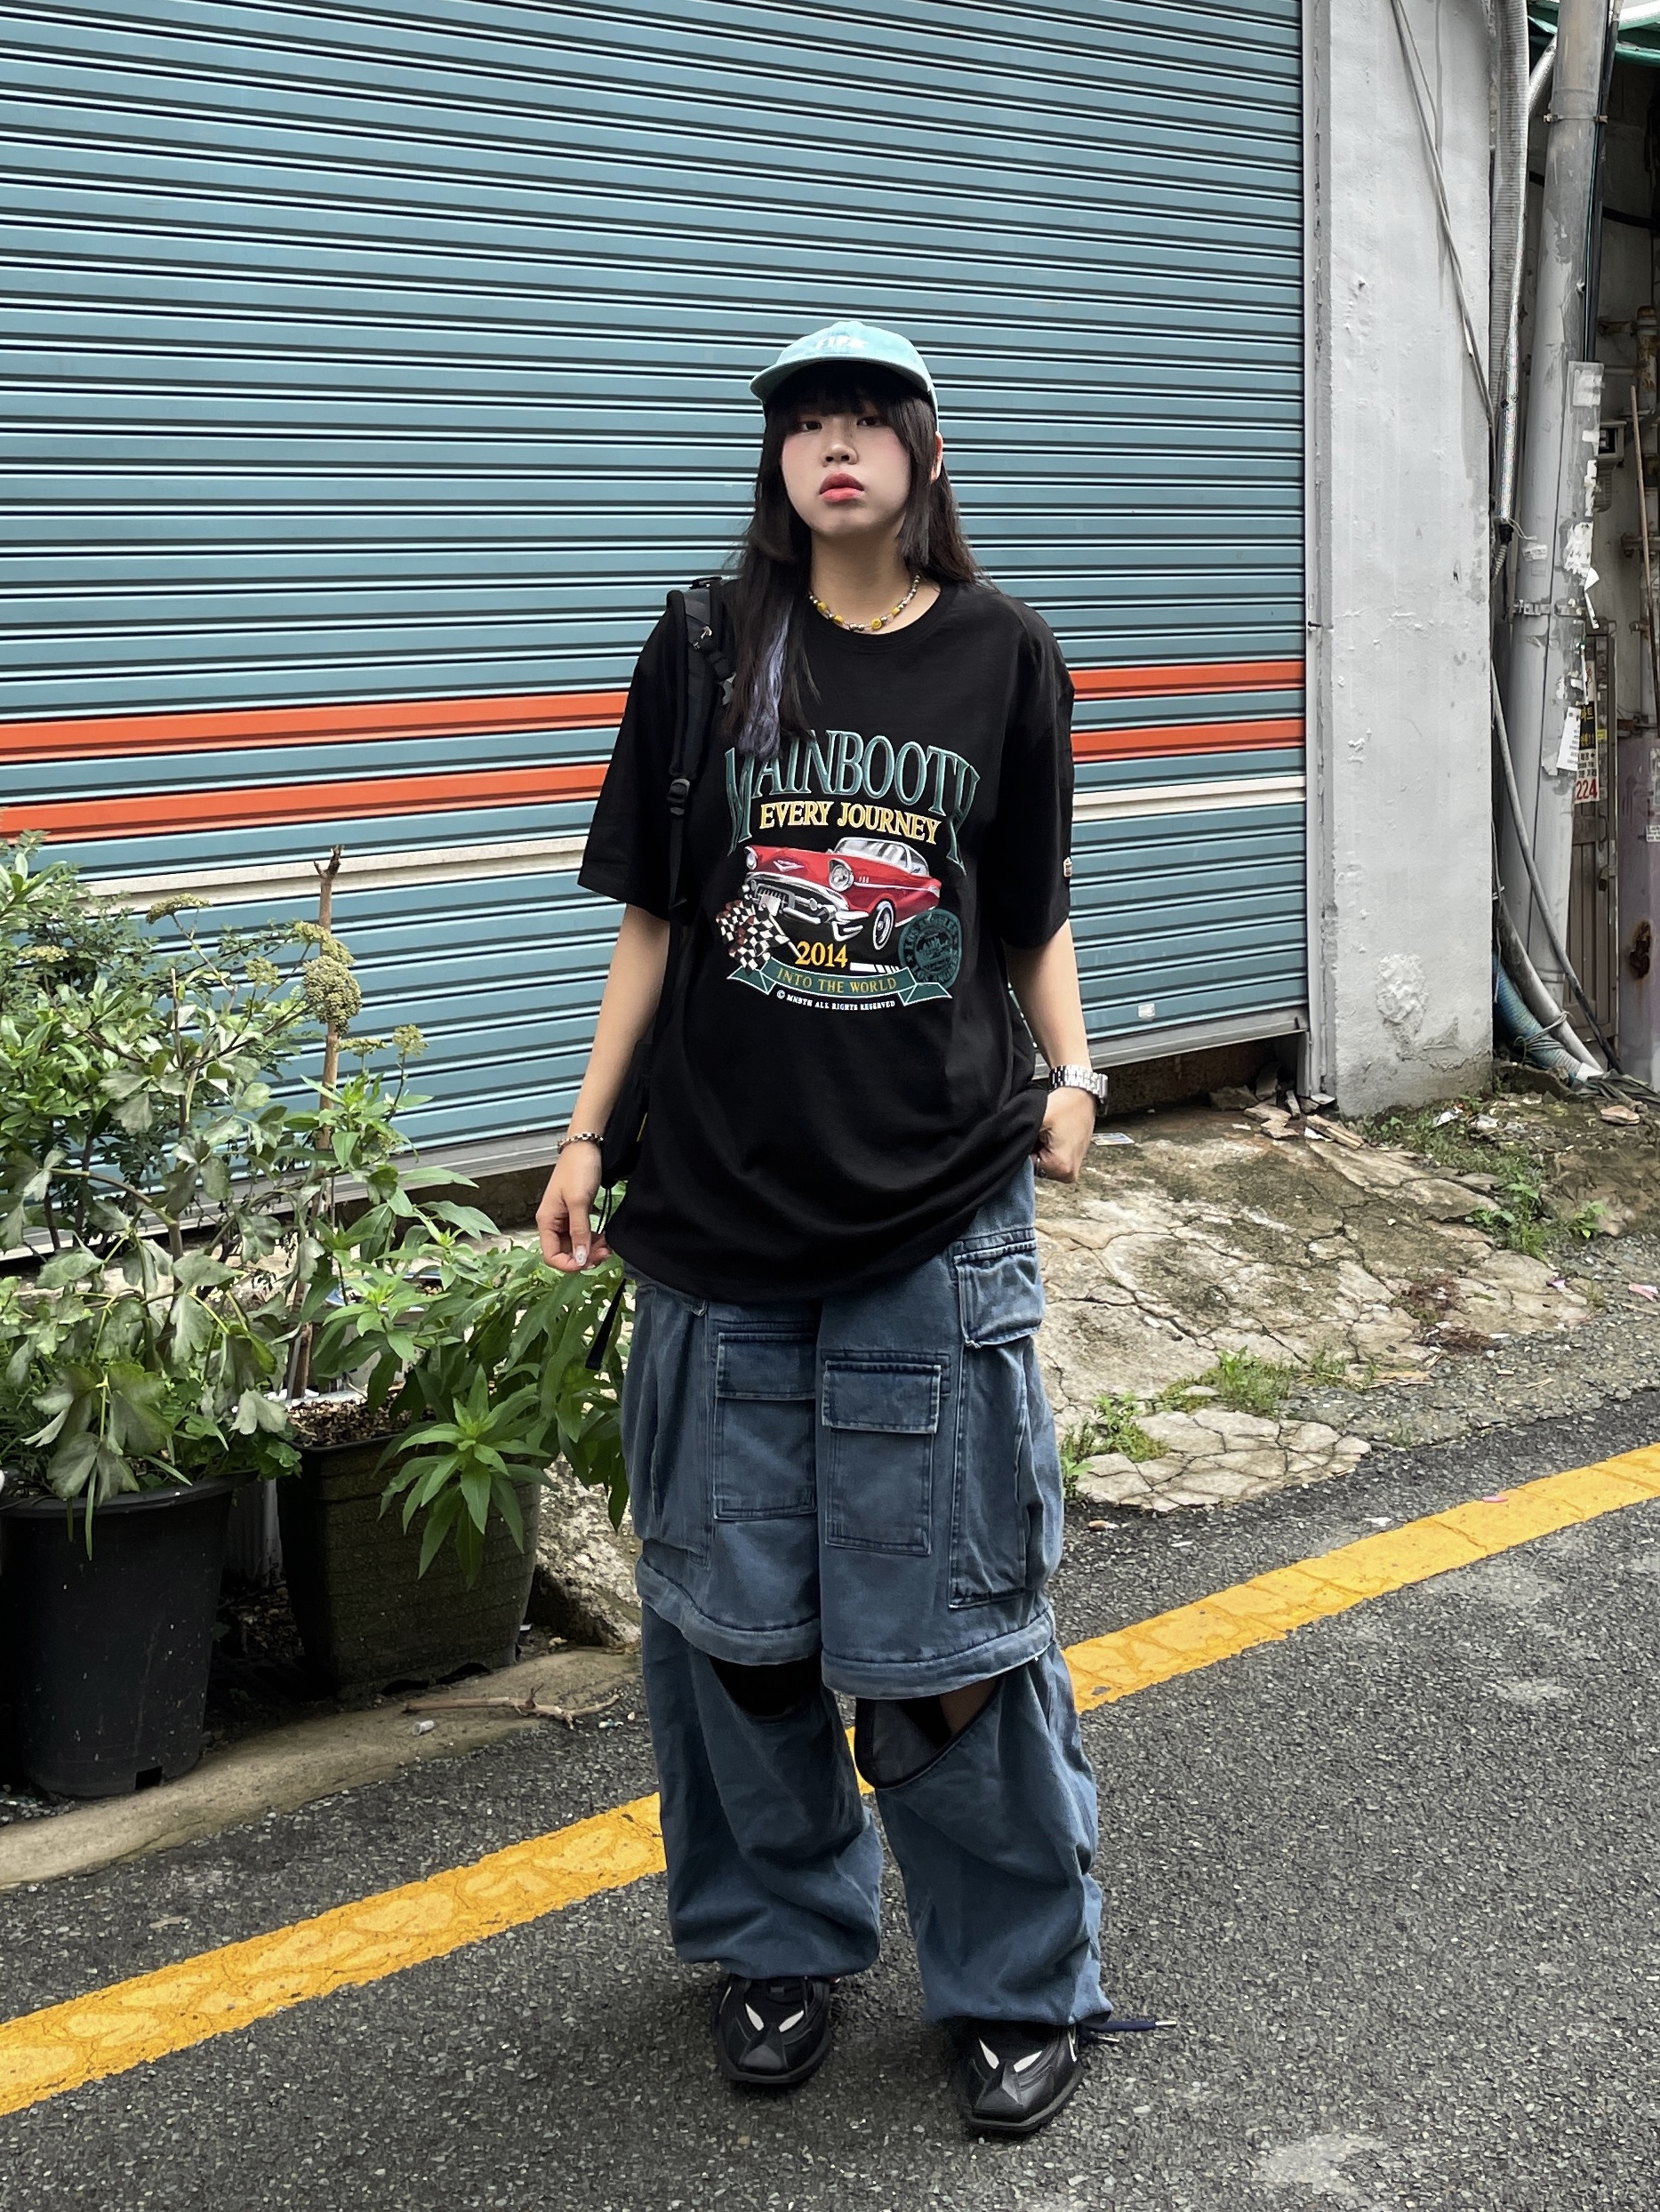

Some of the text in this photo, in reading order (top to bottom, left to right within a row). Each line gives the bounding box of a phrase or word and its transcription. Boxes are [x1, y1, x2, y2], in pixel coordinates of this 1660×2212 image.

[758, 800, 942, 845] EVERY JOURNEY
[796, 941, 848, 968] 2014
[776, 967, 897, 993] INTO THE WORLD
[815, 1001, 830, 1009] ALL
[831, 1003, 858, 1011] RIGHTS
[860, 1000, 895, 1011] RESERVED
